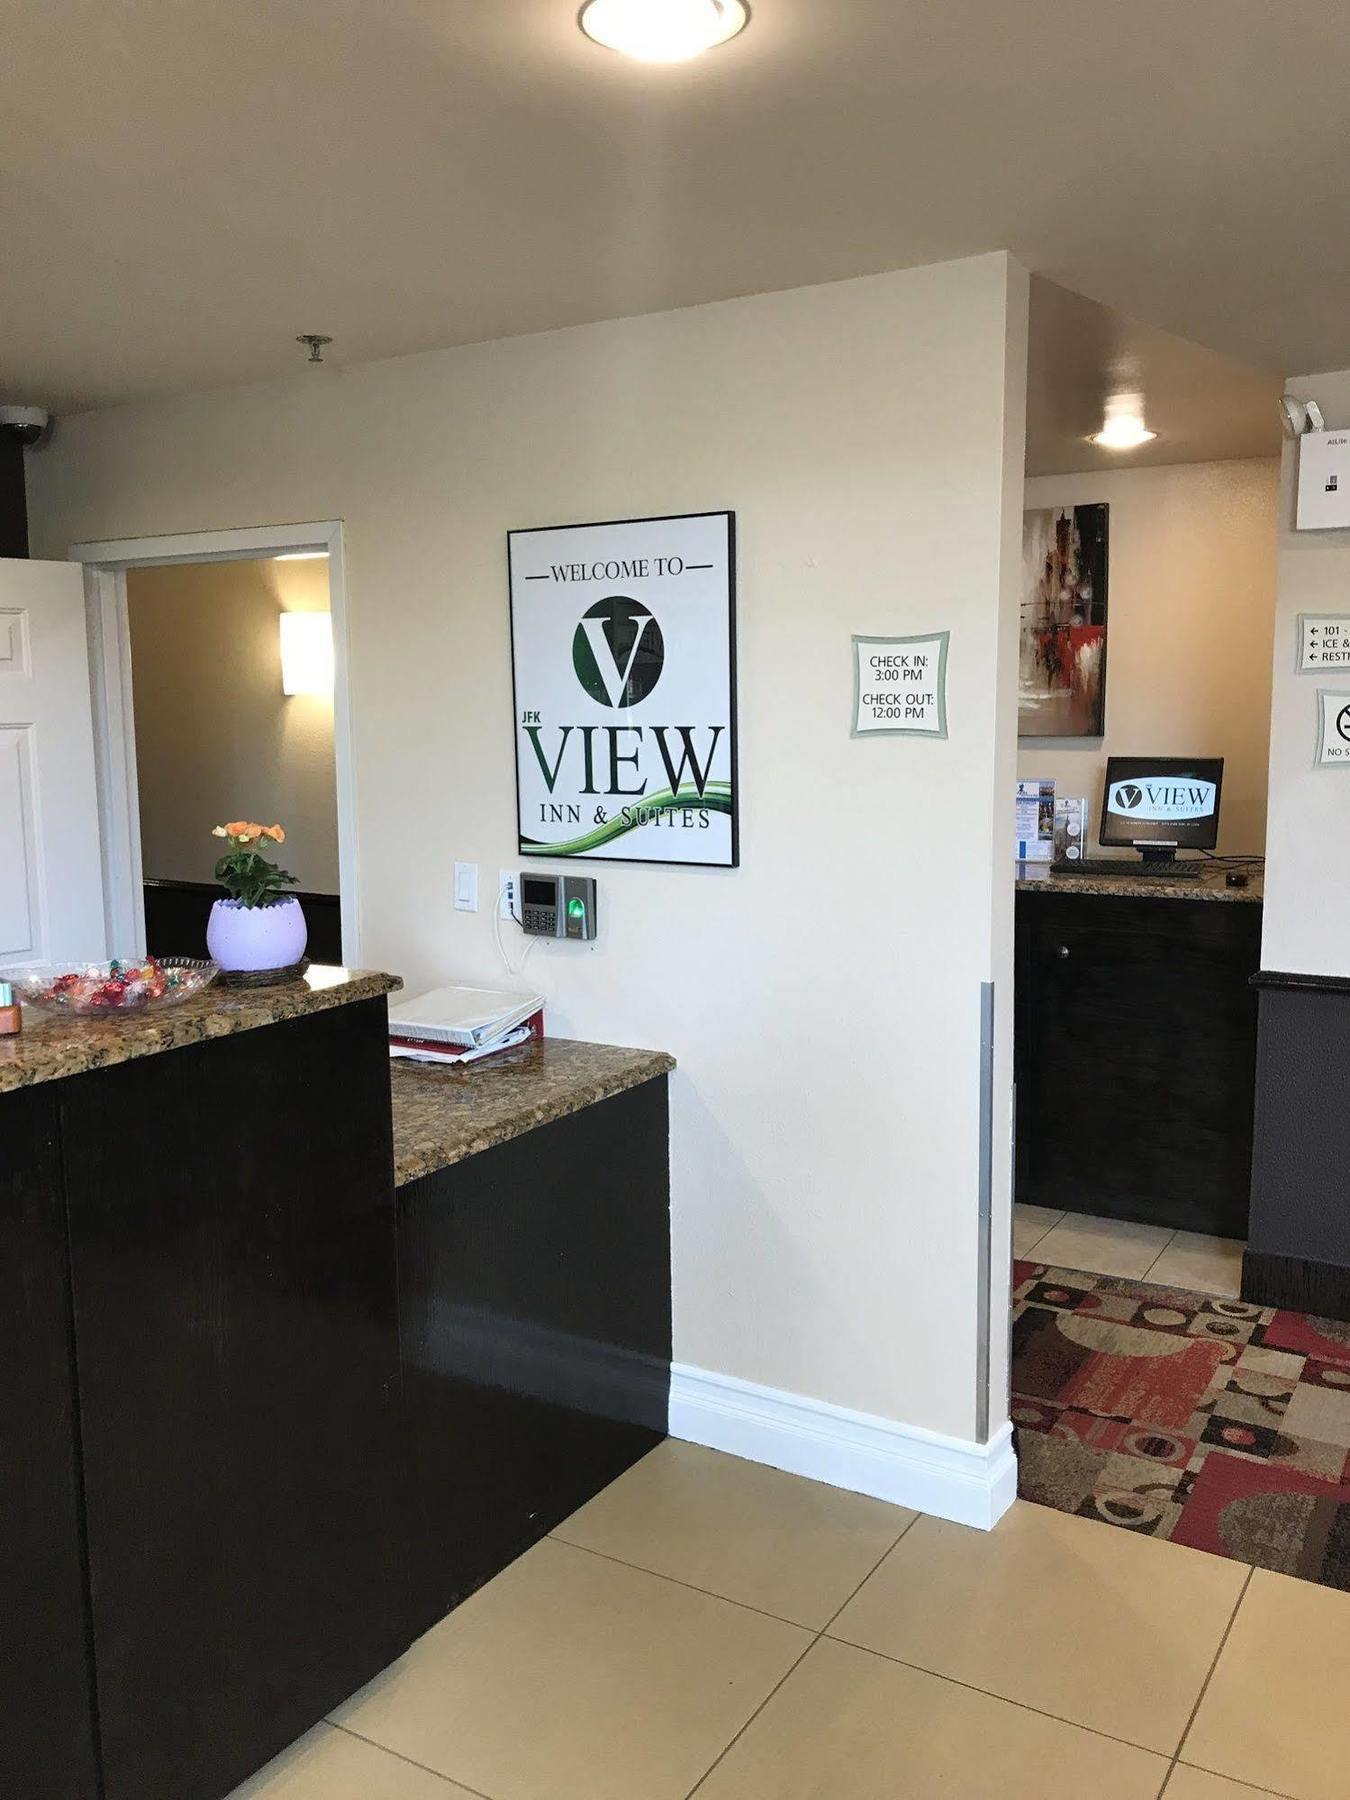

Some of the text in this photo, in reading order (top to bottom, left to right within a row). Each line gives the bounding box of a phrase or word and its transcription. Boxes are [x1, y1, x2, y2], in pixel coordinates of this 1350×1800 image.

[550, 556, 684, 582] WELCOME TO
[1324, 626, 1340, 636] 101
[1322, 638, 1350, 649] ICE &
[870, 655, 929, 668] CHECK IN:
[874, 669, 923, 681] 3:00 PM
[862, 693, 934, 705] CHECK OUT:
[521, 711, 542, 724] JFK
[872, 706, 925, 719] 12:00 PM
[1327, 747, 1342, 756] NO
[522, 726, 726, 798] VIEW
[1146, 787, 1210, 806] VIEW
[539, 803, 711, 829] INN & SUITES
